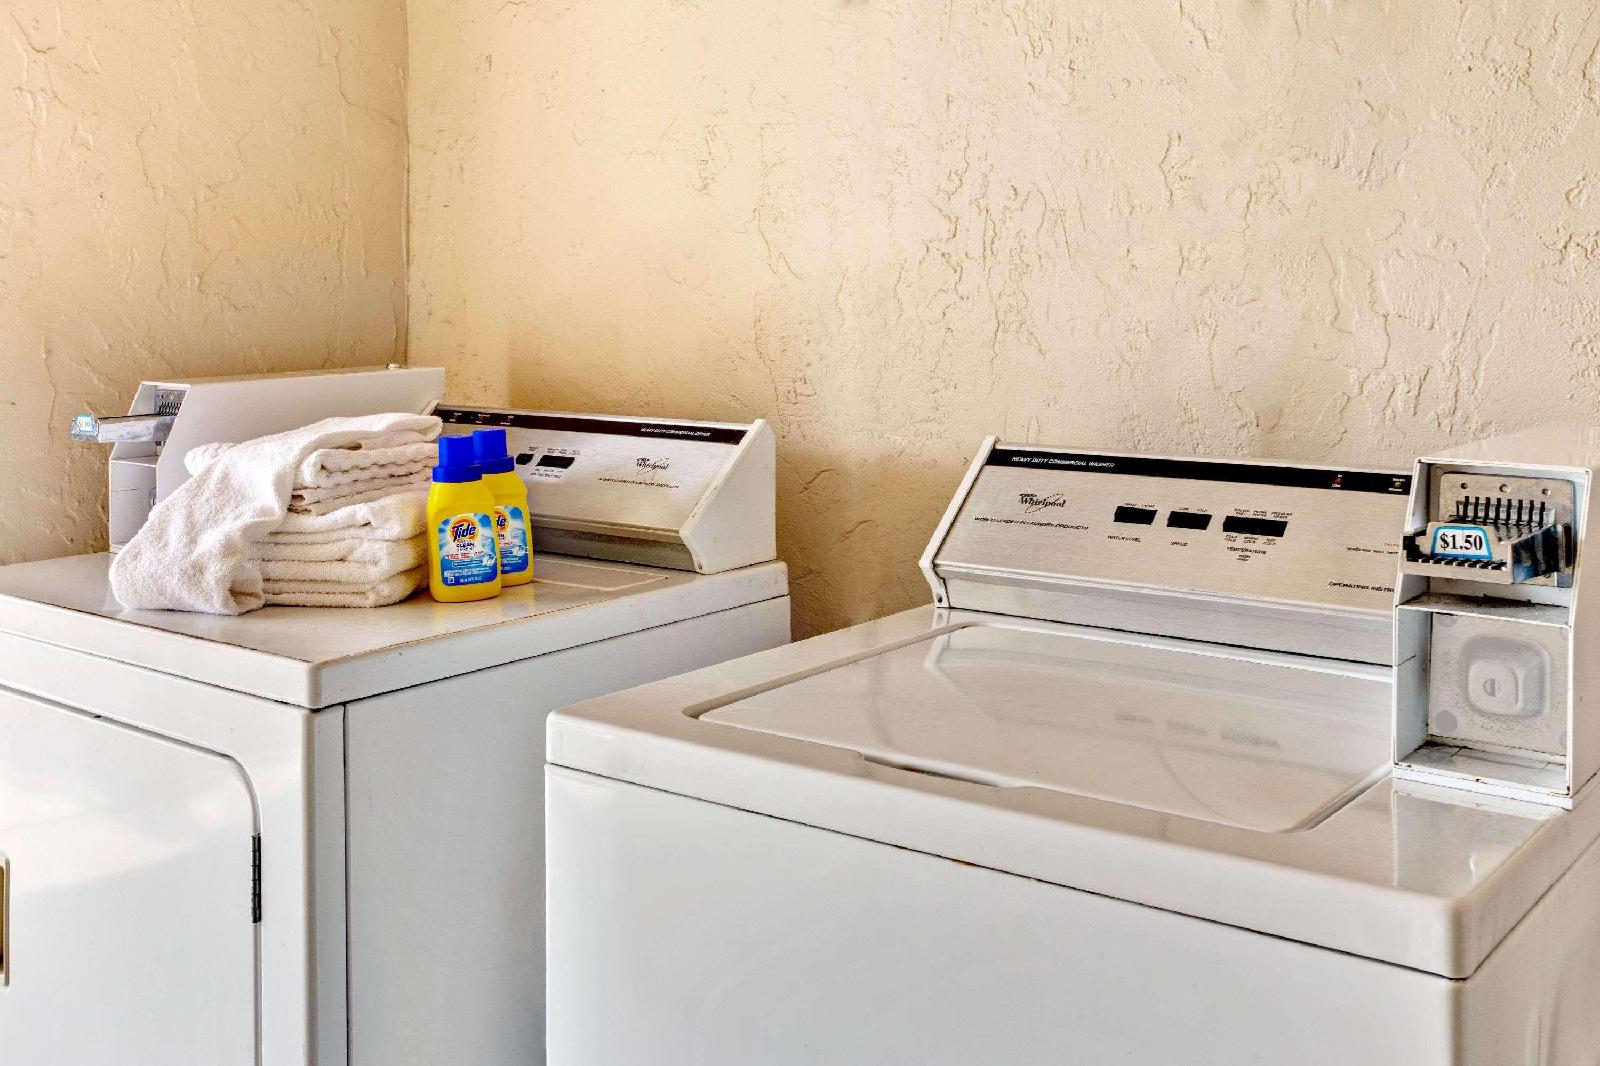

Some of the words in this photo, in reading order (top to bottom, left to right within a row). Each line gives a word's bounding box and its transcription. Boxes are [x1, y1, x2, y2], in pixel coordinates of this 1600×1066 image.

[1048, 458, 1087, 466] COMMERCIAL
[1019, 496, 1066, 508] Whirlpool
[451, 523, 477, 542] Tide
[1440, 532, 1483, 551] $1.50
